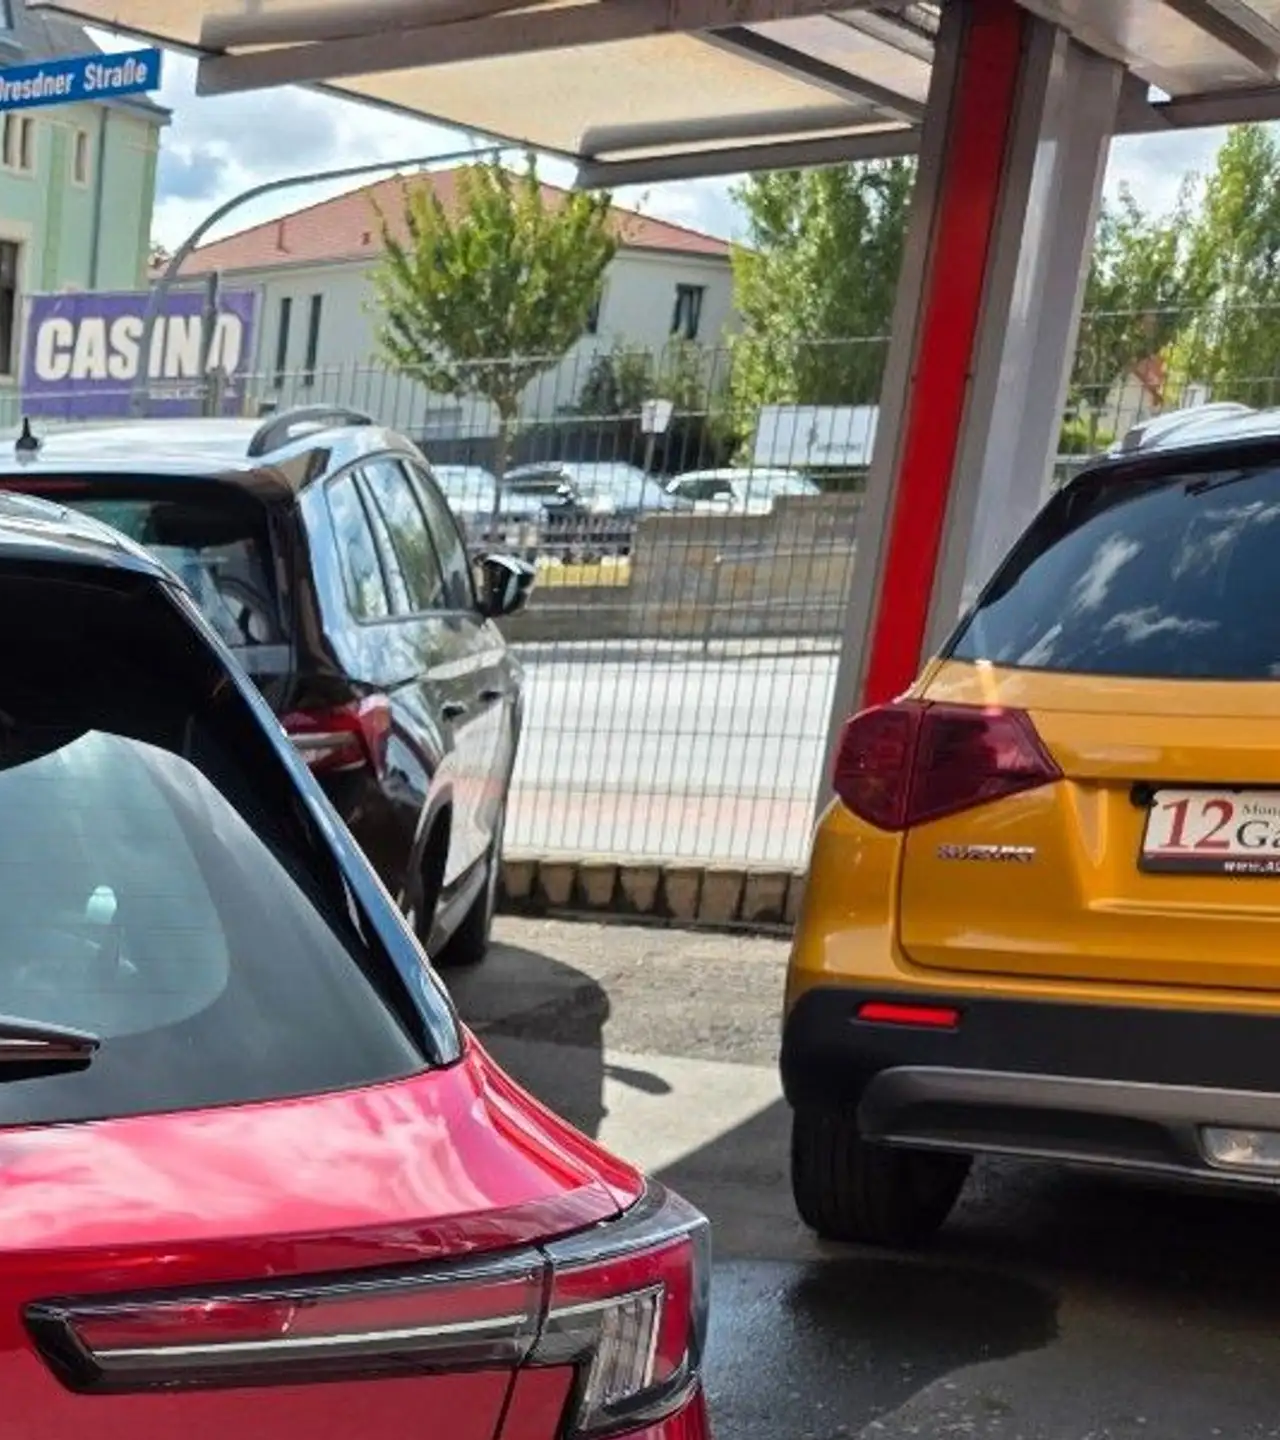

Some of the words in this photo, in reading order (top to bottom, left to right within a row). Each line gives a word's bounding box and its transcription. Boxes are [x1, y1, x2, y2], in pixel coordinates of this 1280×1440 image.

[83, 57, 148, 92] Straße
[34, 313, 243, 381] CASINO
[1157, 799, 1236, 850] 12
